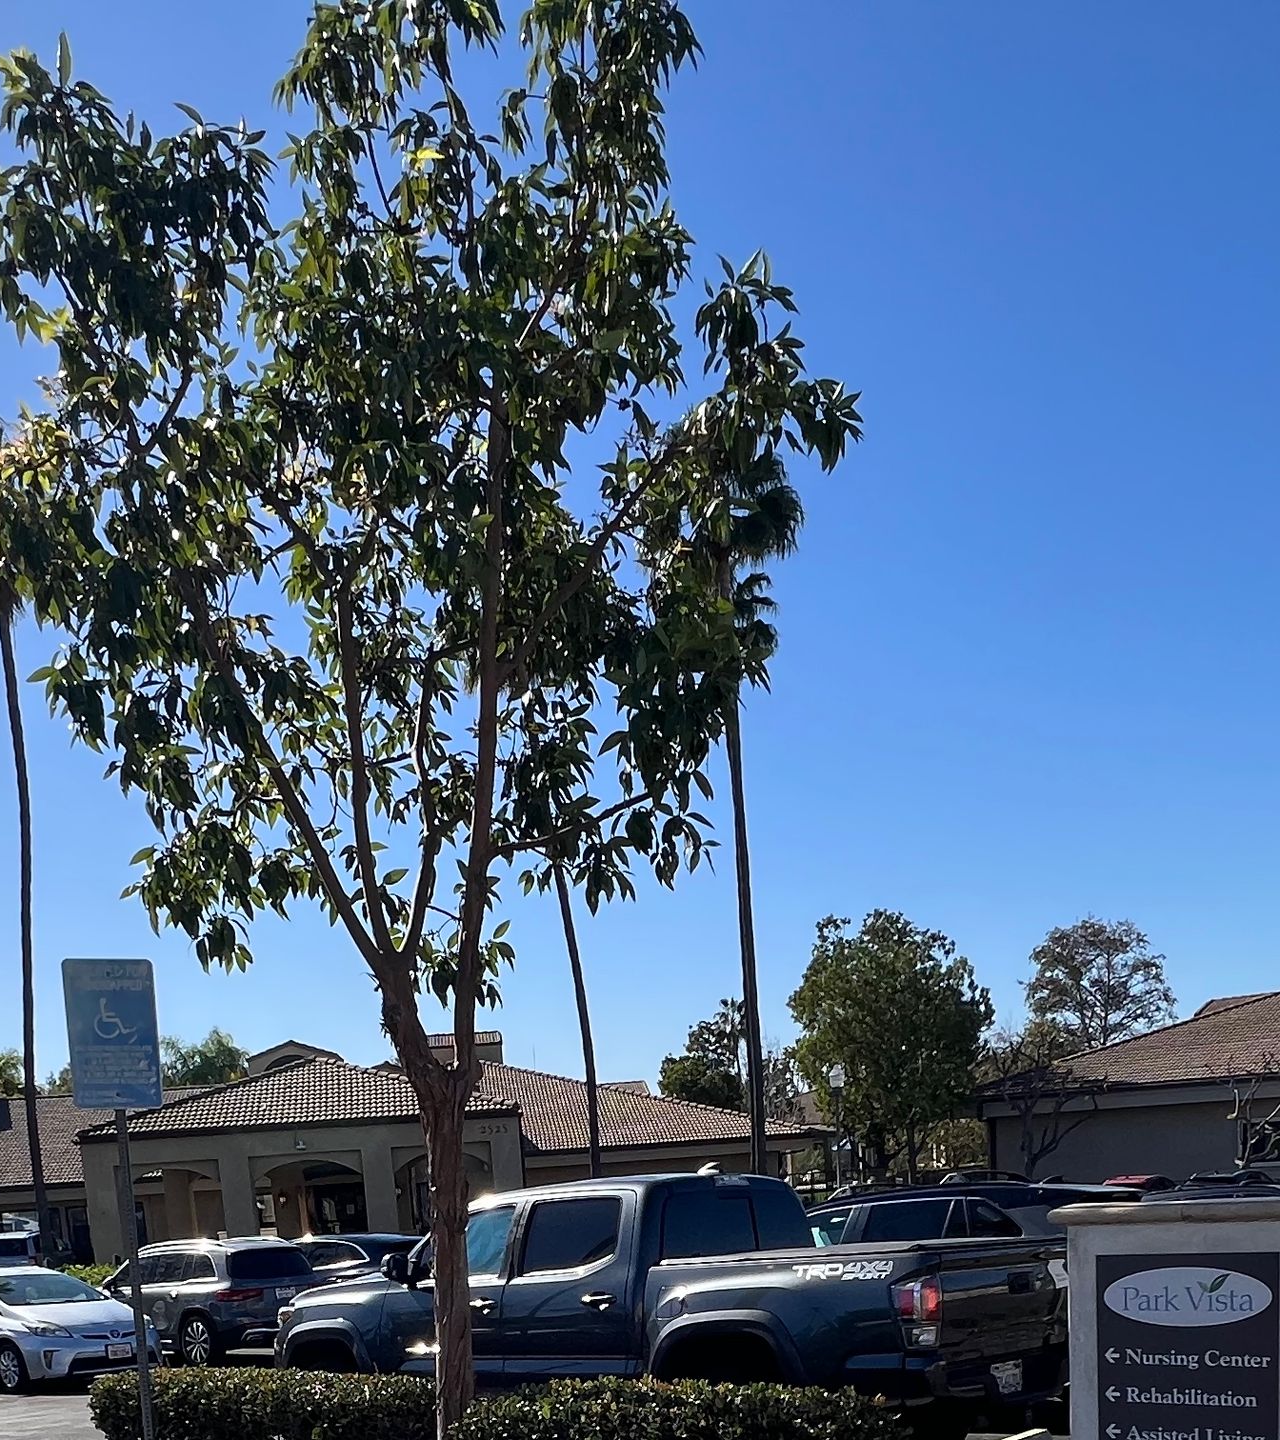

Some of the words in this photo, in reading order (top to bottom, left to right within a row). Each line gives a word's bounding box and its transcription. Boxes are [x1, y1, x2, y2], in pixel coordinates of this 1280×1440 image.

[792, 1263, 844, 1280] TRD
[841, 1272, 889, 1281] SPORT
[1121, 1286, 1180, 1312] Park
[1184, 1286, 1254, 1312] Vista
[1124, 1348, 1199, 1370] Nursing
[1204, 1349, 1271, 1368] Center
[1126, 1386, 1258, 1407] Rehabilitation
